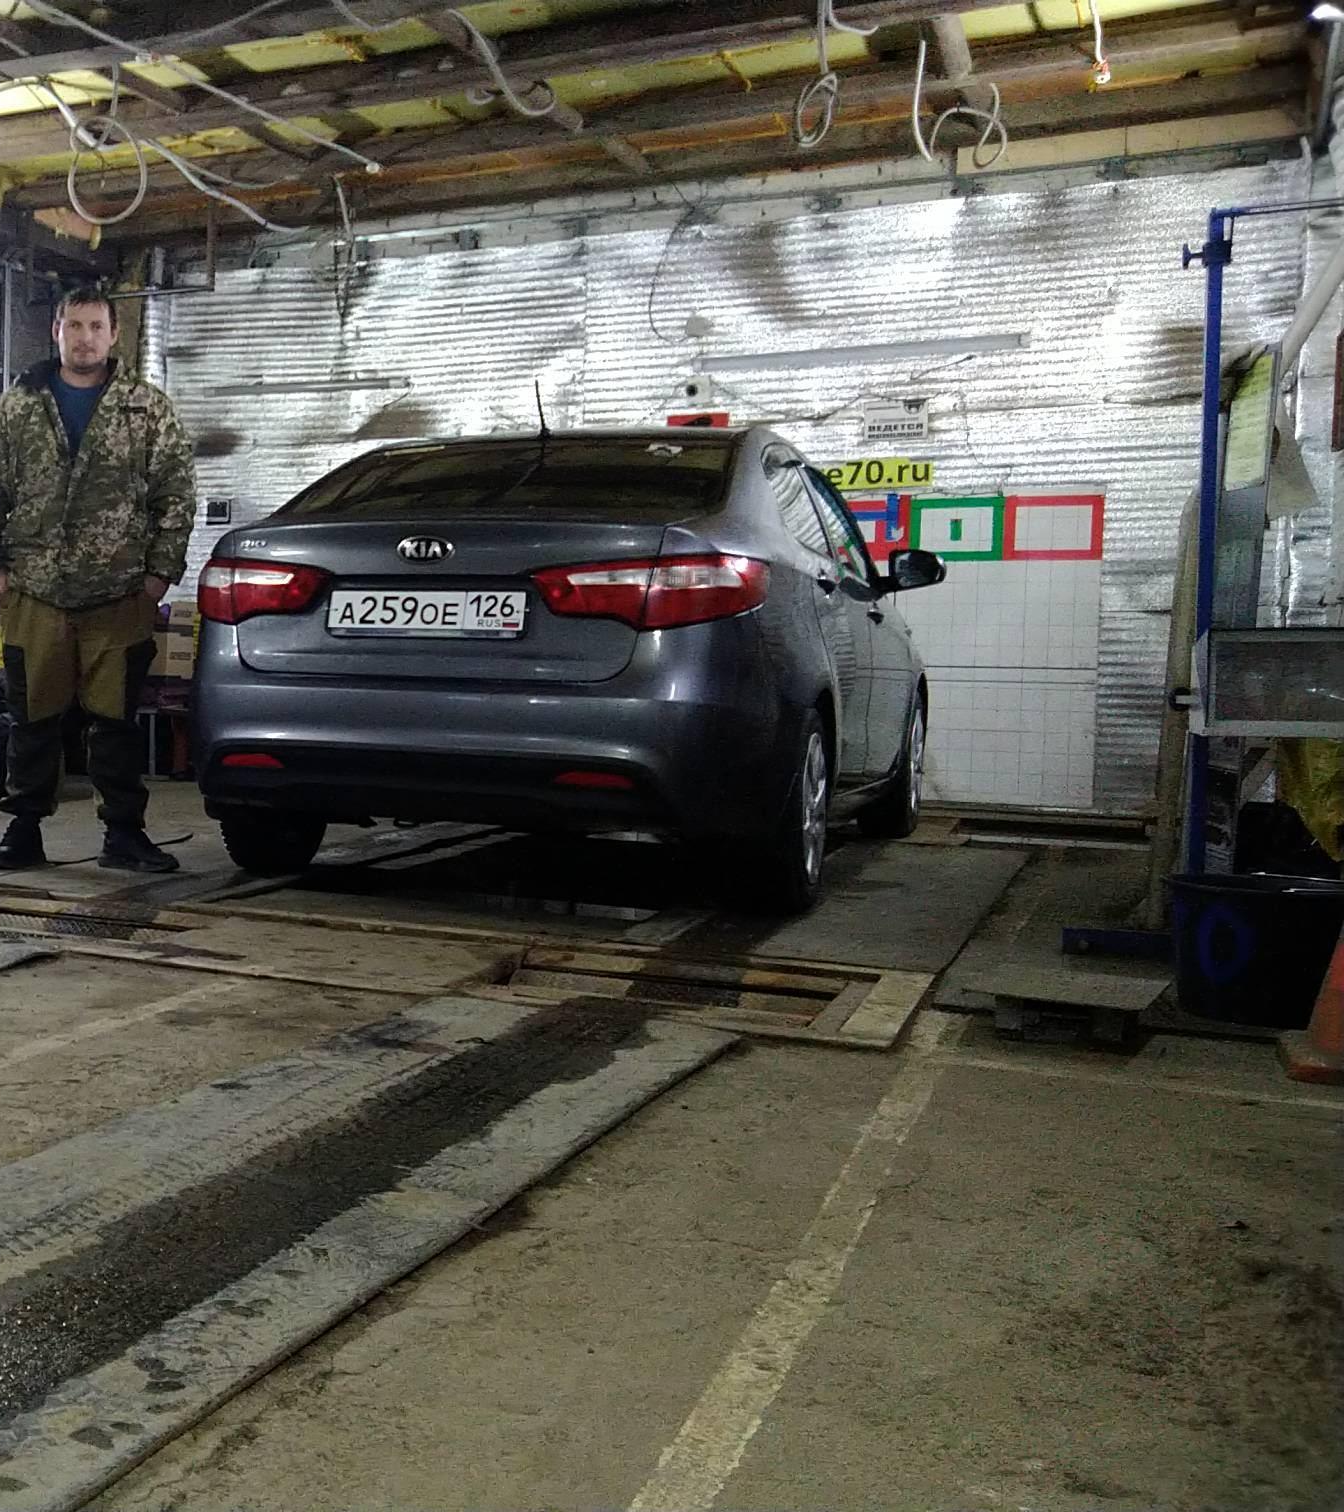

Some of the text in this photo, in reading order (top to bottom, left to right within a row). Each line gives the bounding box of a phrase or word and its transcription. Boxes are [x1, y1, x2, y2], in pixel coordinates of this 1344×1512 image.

[868, 423, 923, 432] ВЕДЕТСЯ
[822, 460, 929, 485] e70.ru
[404, 541, 443, 558] KIA
[339, 594, 514, 625] А259ОЕ 126
[477, 618, 501, 628] RUS
